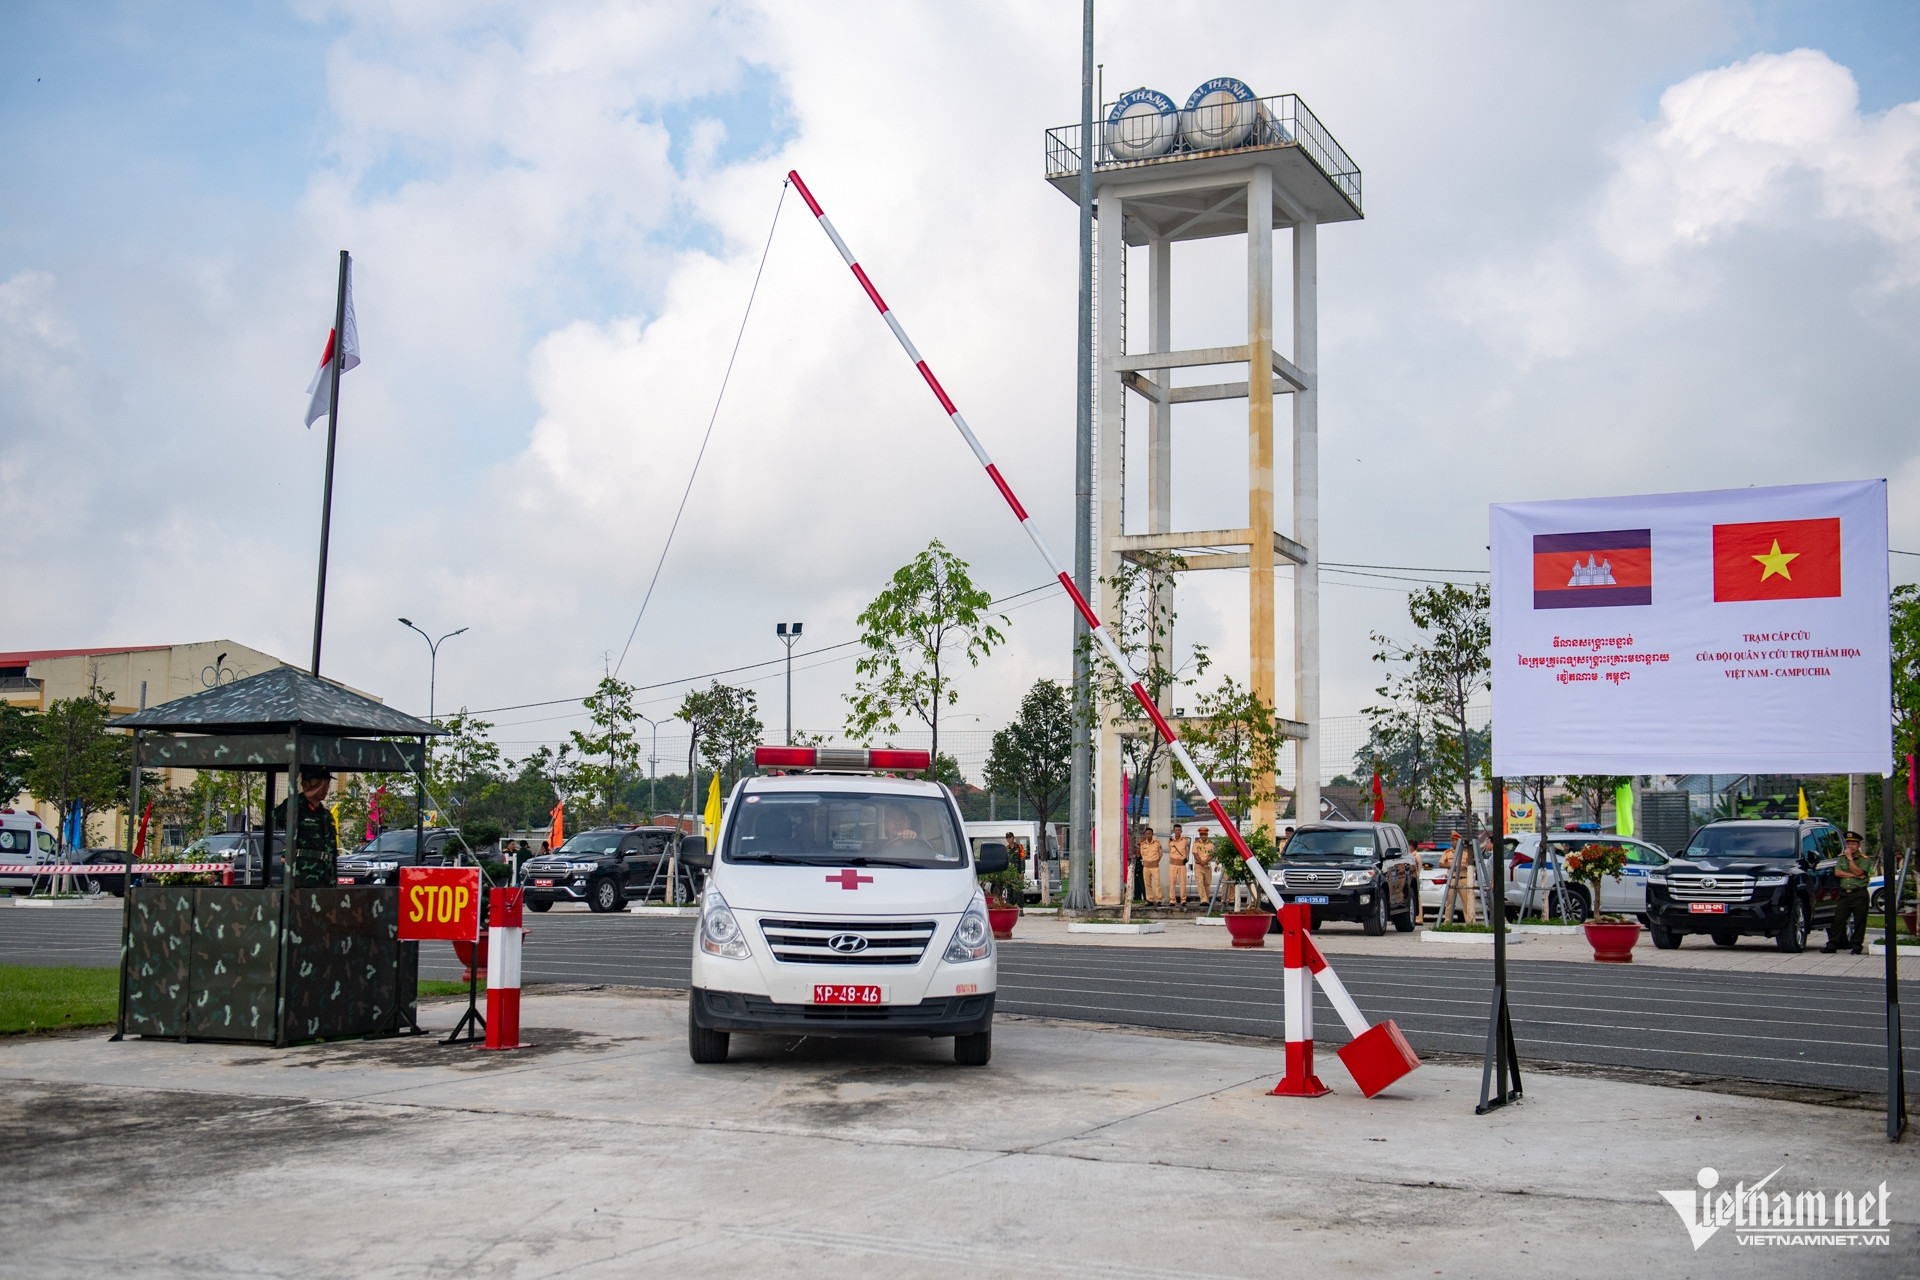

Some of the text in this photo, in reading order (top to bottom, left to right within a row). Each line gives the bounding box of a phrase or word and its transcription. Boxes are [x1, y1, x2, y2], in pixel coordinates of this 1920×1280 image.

[1743, 633, 1769, 643] TRẠM
[1791, 630, 1811, 641] CỨU
[1696, 647, 1862, 662] CỦA ĐỘI QUÂN Y CỨU TRỢ THẢM HỌA
[1725, 669, 1746, 680] VIỆT
[1747, 668, 1769, 678] NAM
[1775, 667, 1831, 677] CAMPUCHIA
[409, 885, 469, 923] STOP
